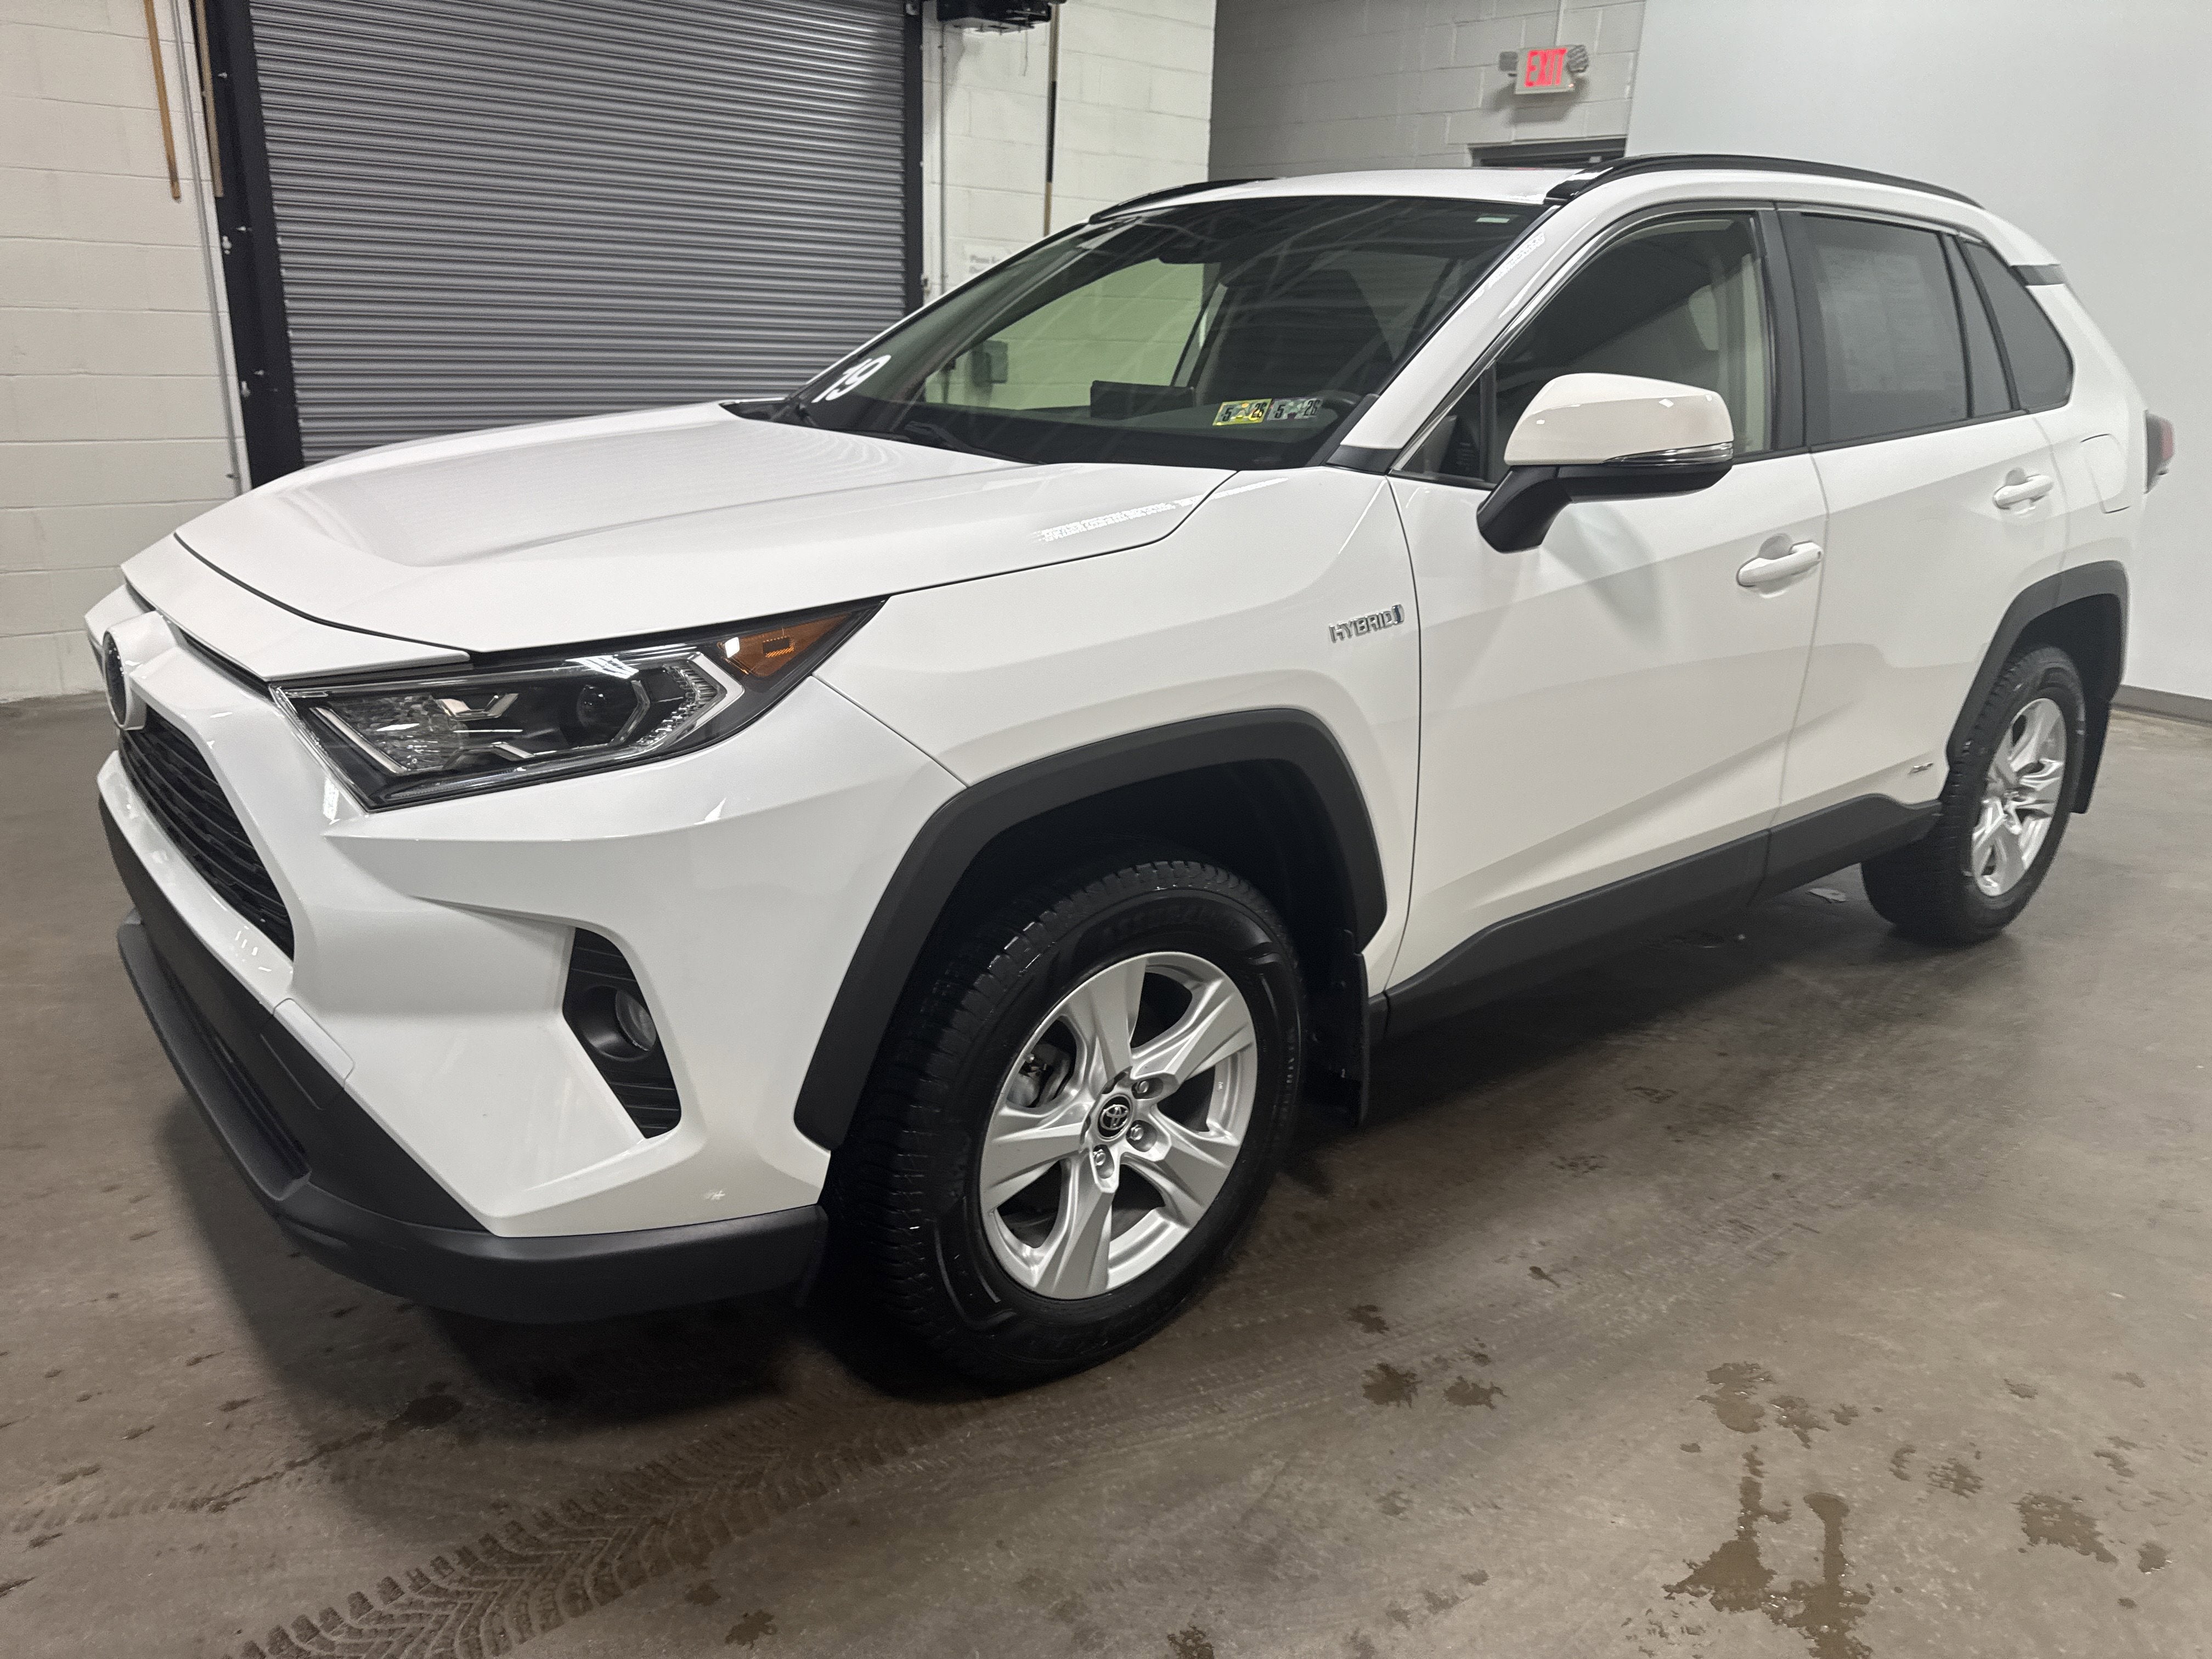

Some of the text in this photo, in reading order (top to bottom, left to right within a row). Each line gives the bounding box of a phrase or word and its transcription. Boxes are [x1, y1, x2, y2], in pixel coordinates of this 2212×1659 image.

[1523, 47, 1568, 88] EXIT
[811, 354, 891, 403] 19
[1221, 403, 1267, 421] 5 26
[1274, 399, 1321, 418] 5 26
[1329, 611, 1393, 644] HYBRID
